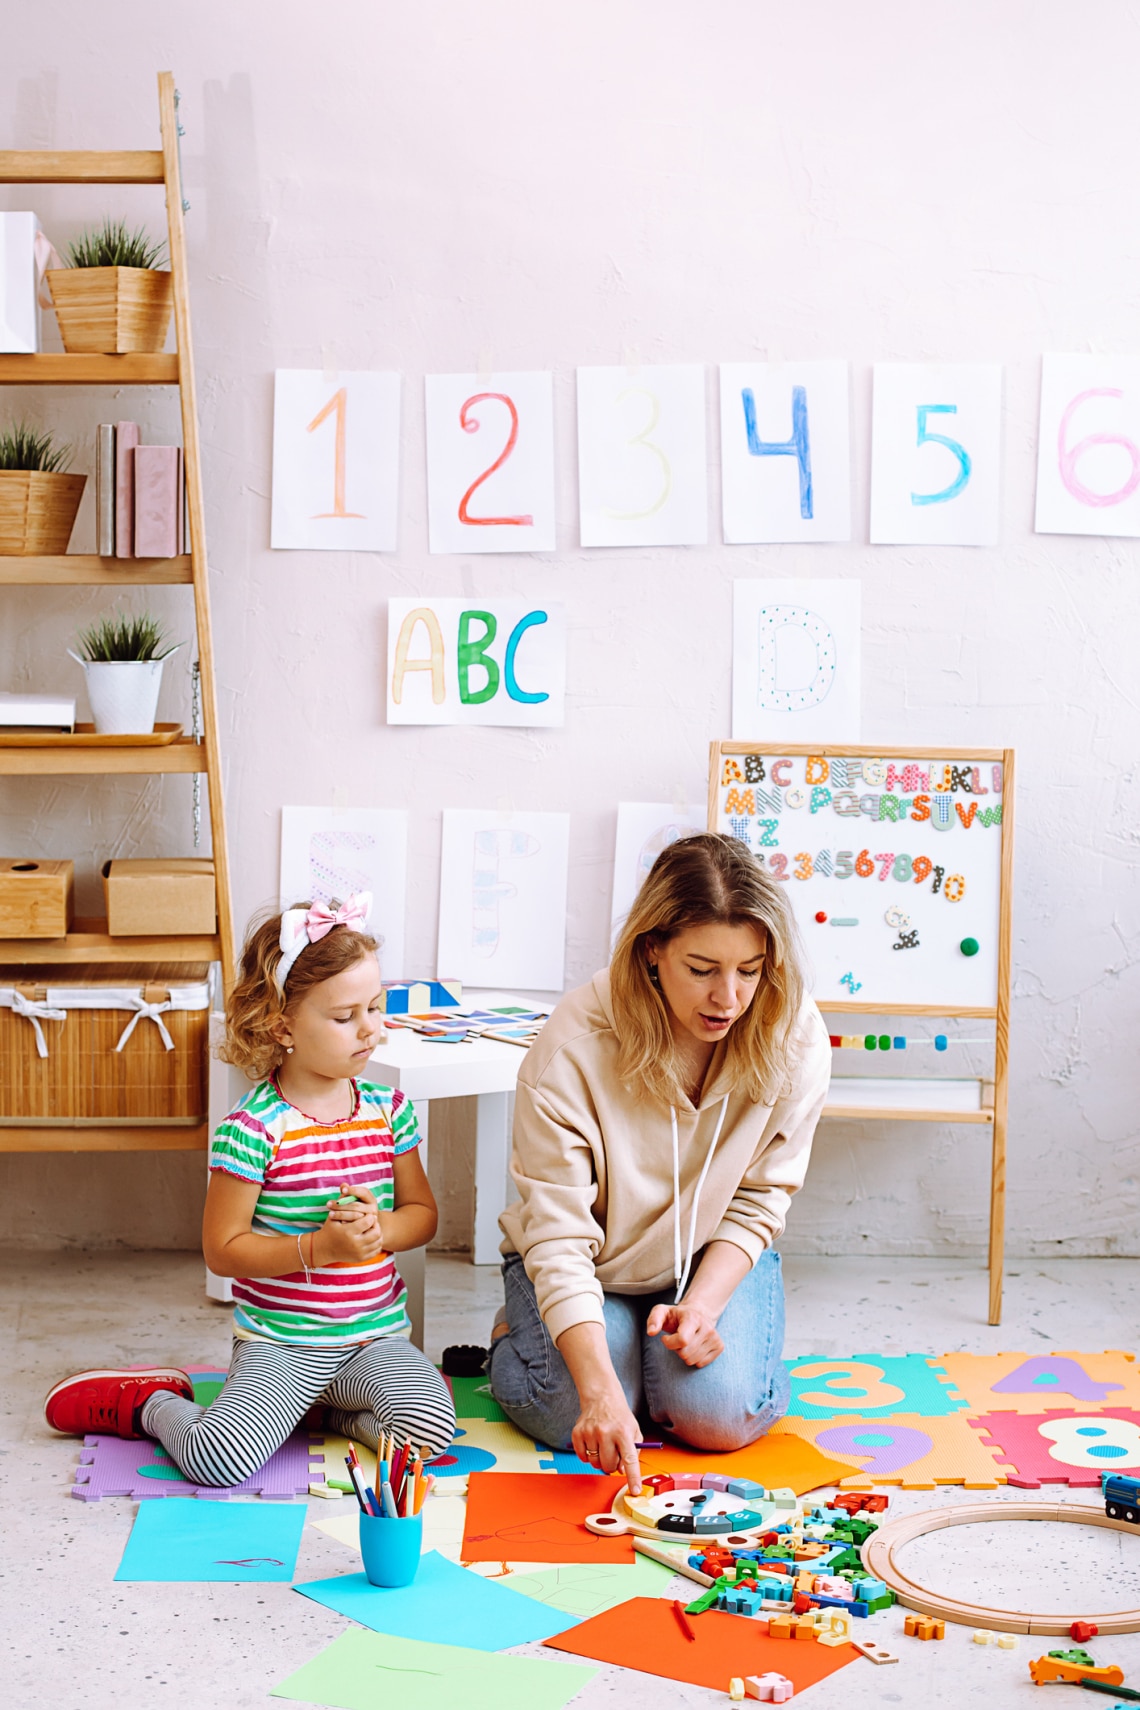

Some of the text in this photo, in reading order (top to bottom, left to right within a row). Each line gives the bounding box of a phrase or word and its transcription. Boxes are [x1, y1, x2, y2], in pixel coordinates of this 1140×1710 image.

[307, 387, 367, 519] 1
[458, 392, 534, 526] 2
[606, 388, 671, 520] 3
[741, 385, 813, 519] 4
[910, 404, 972, 506] 5
[1058, 387, 1140, 508] 6
[392, 607, 550, 705] ABC
[757, 604, 837, 712] D
[790, 1362, 906, 1408] 3
[990, 1356, 1125, 1402] 4
[815, 1424, 934, 1475] 9
[1038, 1417, 1140, 1469] 8
[669, 1515, 686, 1523] 12
[704, 1516, 719, 1524] 11
[734, 1512, 751, 1520] 10
